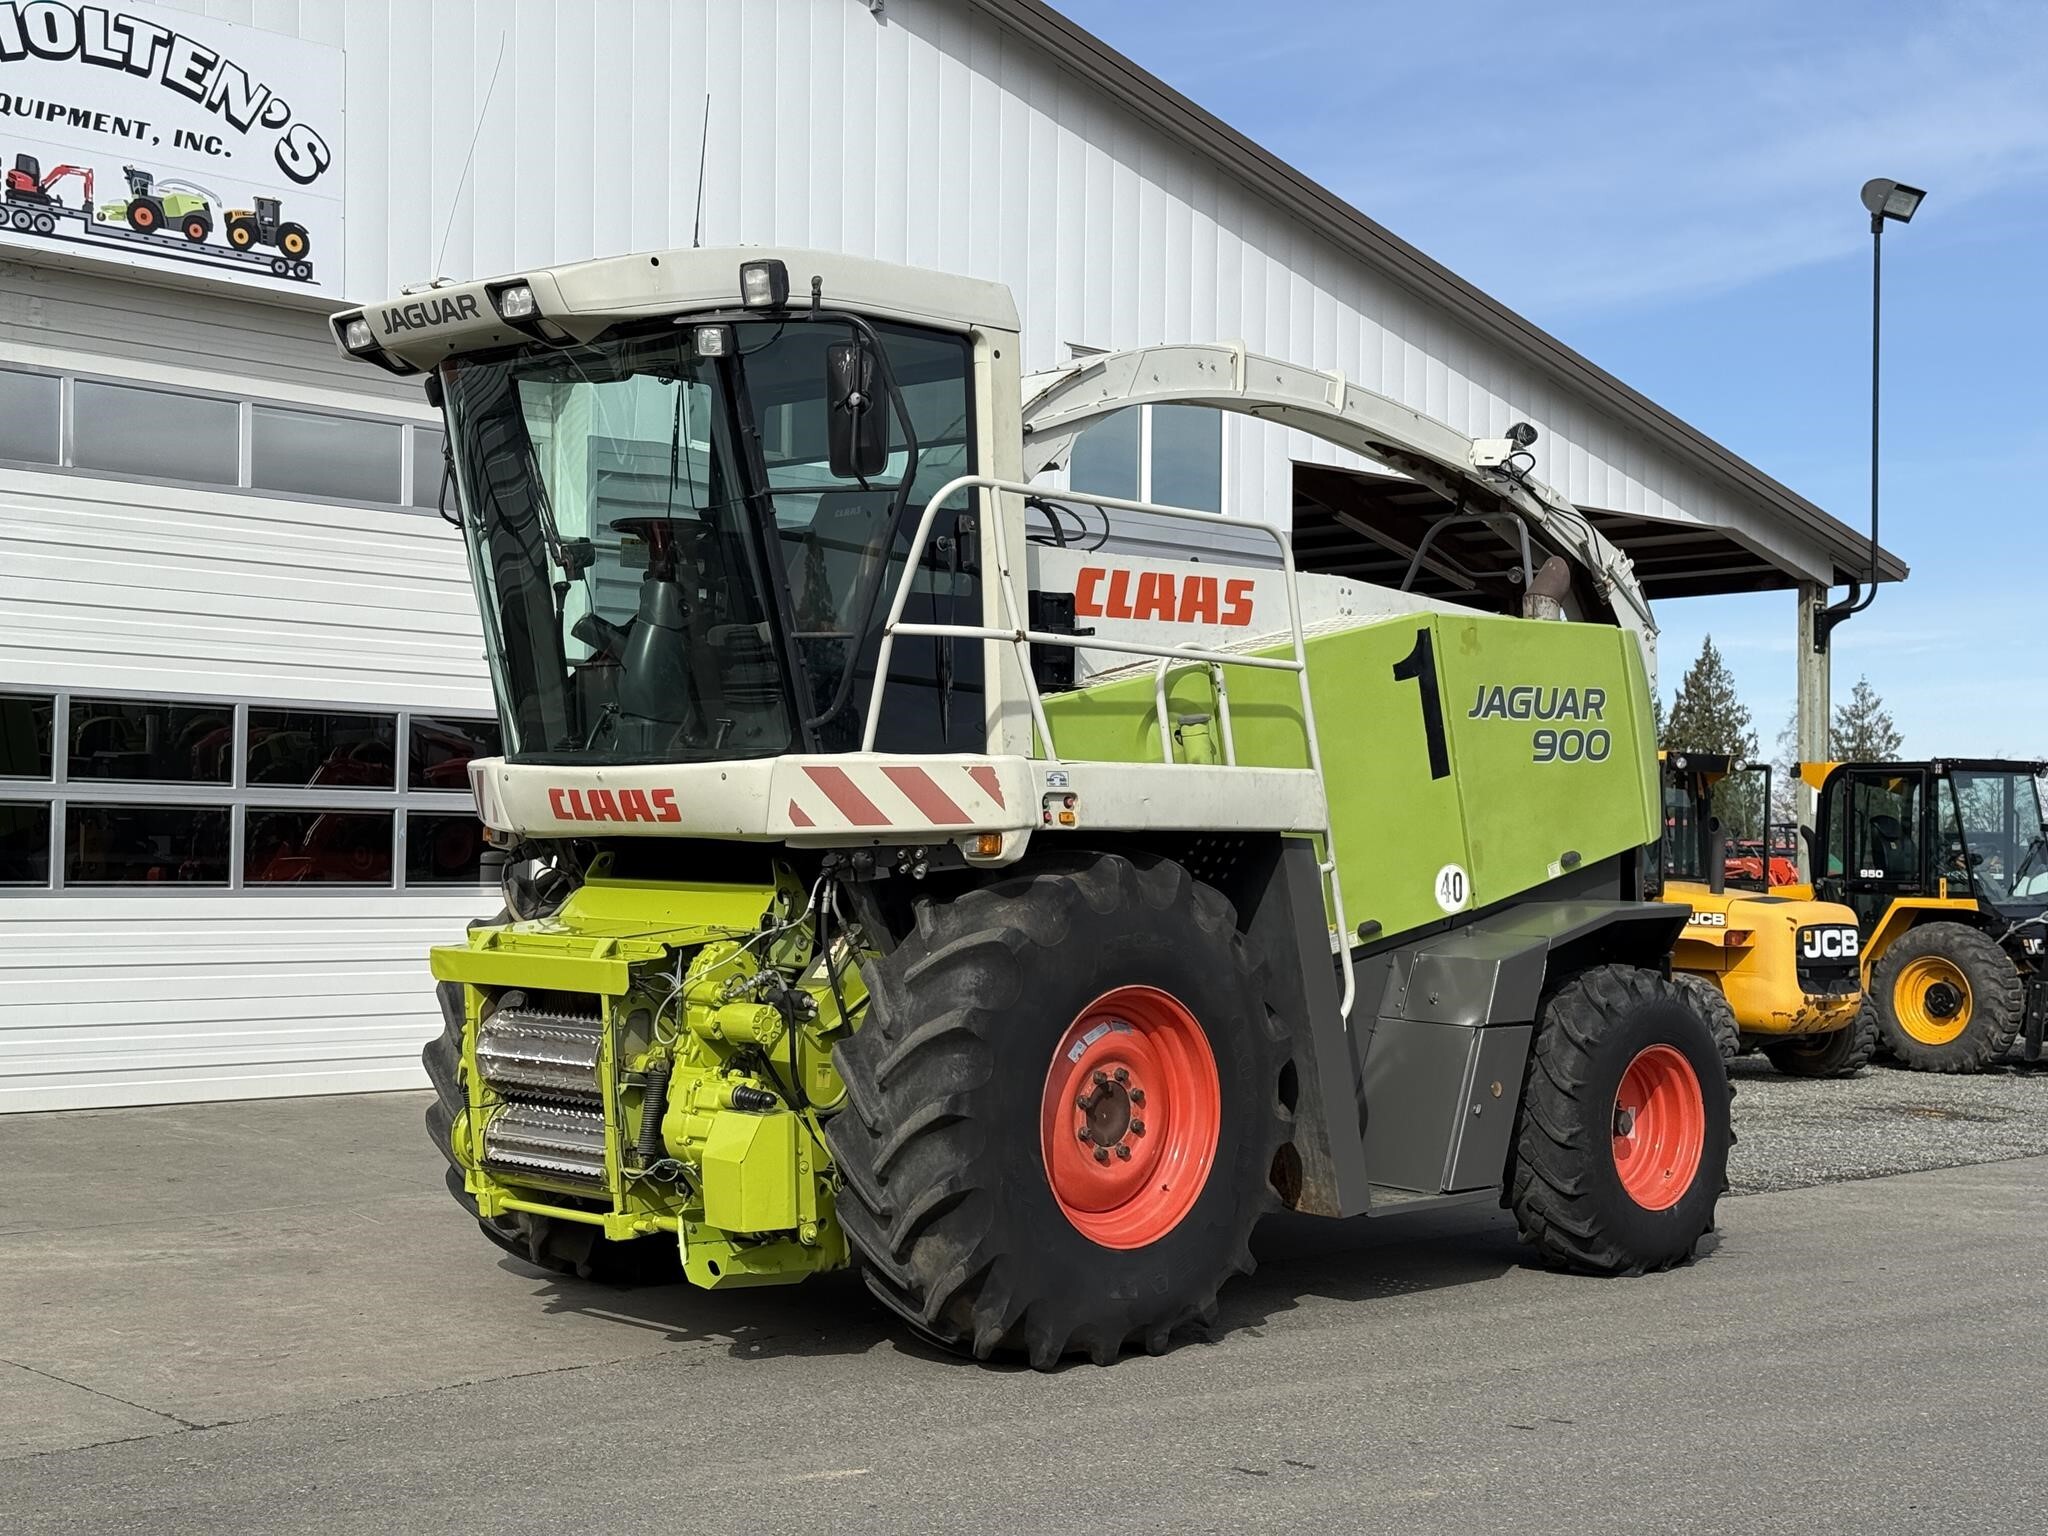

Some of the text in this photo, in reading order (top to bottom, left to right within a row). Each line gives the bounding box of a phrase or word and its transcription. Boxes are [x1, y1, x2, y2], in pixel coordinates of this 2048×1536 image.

[173, 129, 232, 158] INC.
[381, 294, 481, 335] JAGUAR
[1075, 567, 1255, 626] CLAAS
[1392, 627, 1451, 780] 1
[1467, 684, 1607, 721] JAGUAR
[1532, 728, 1612, 763] 900
[548, 788, 682, 822] CLAAS
[1440, 872, 1462, 903] 40
[1688, 913, 1726, 926] JCB
[1803, 929, 1859, 958] JCB
